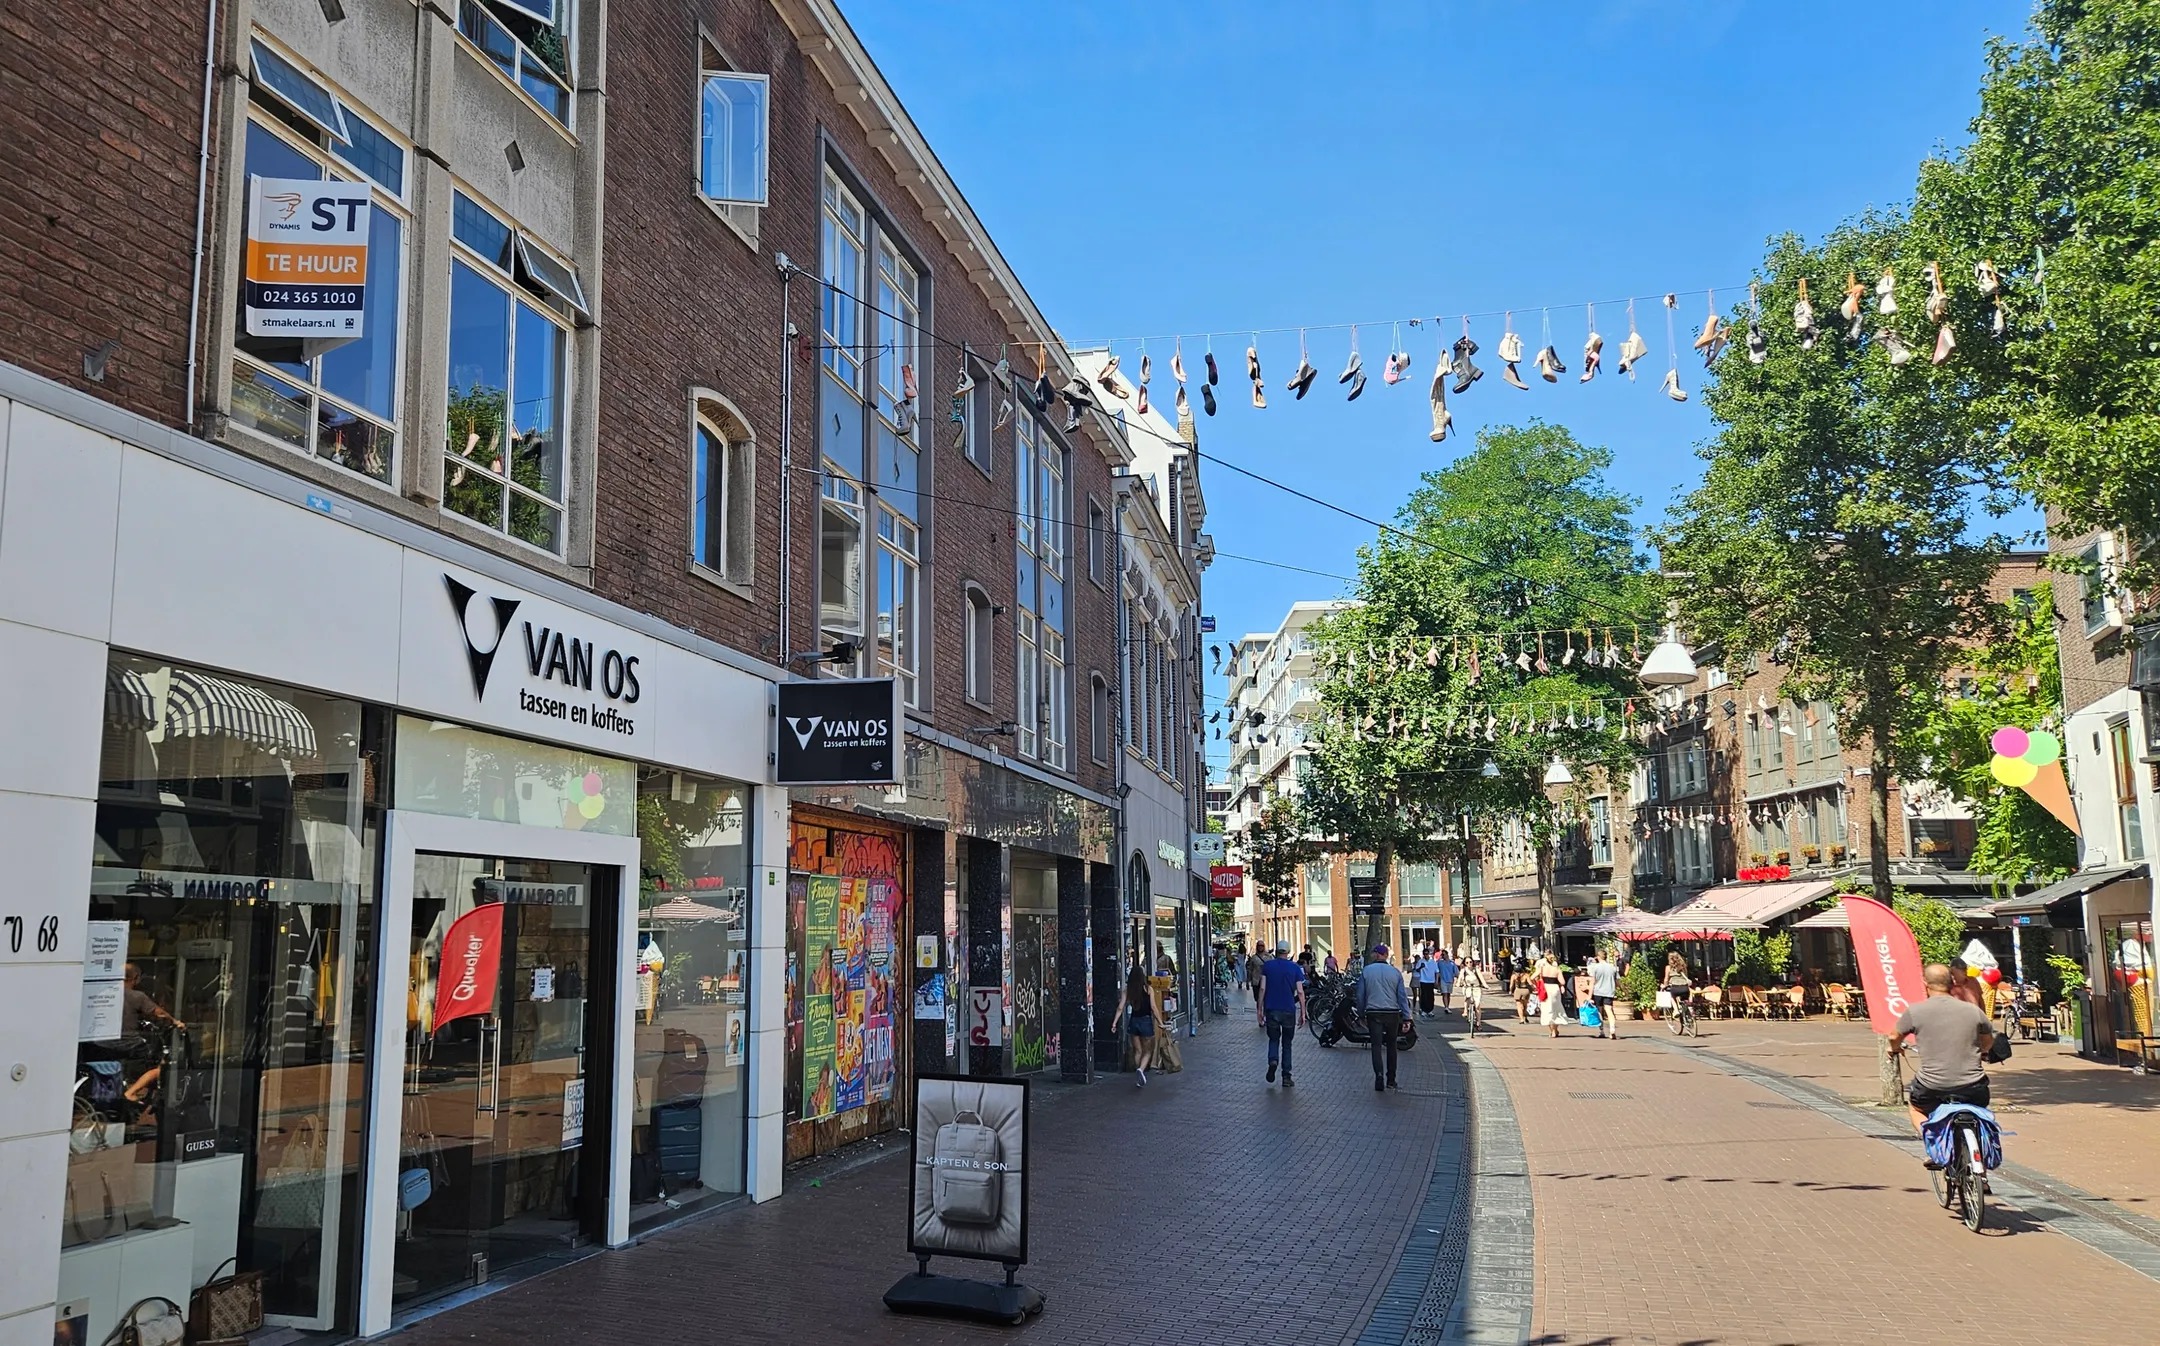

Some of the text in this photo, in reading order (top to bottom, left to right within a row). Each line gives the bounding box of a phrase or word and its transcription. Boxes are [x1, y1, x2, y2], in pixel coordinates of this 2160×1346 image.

[311, 197, 368, 232] ST
[269, 222, 301, 231] DYNAMIS
[265, 253, 359, 274] TE HUUR
[263, 290, 357, 304] 024 365 1010
[261, 318, 336, 328] stmakelaars.nl
[521, 620, 640, 704] VAN OS
[519, 687, 634, 736] tassen en koffers
[823, 719, 888, 738] VAN OS
[823, 738, 887, 748] tassen en koffers
[37, 914, 59, 953] 68
[452, 933, 483, 1001] Quooker
[1874, 933, 1910, 1018] Quooker
[186, 1139, 216, 1152] GUESS
[926, 1156, 1008, 1171] KAPTEN & SON
